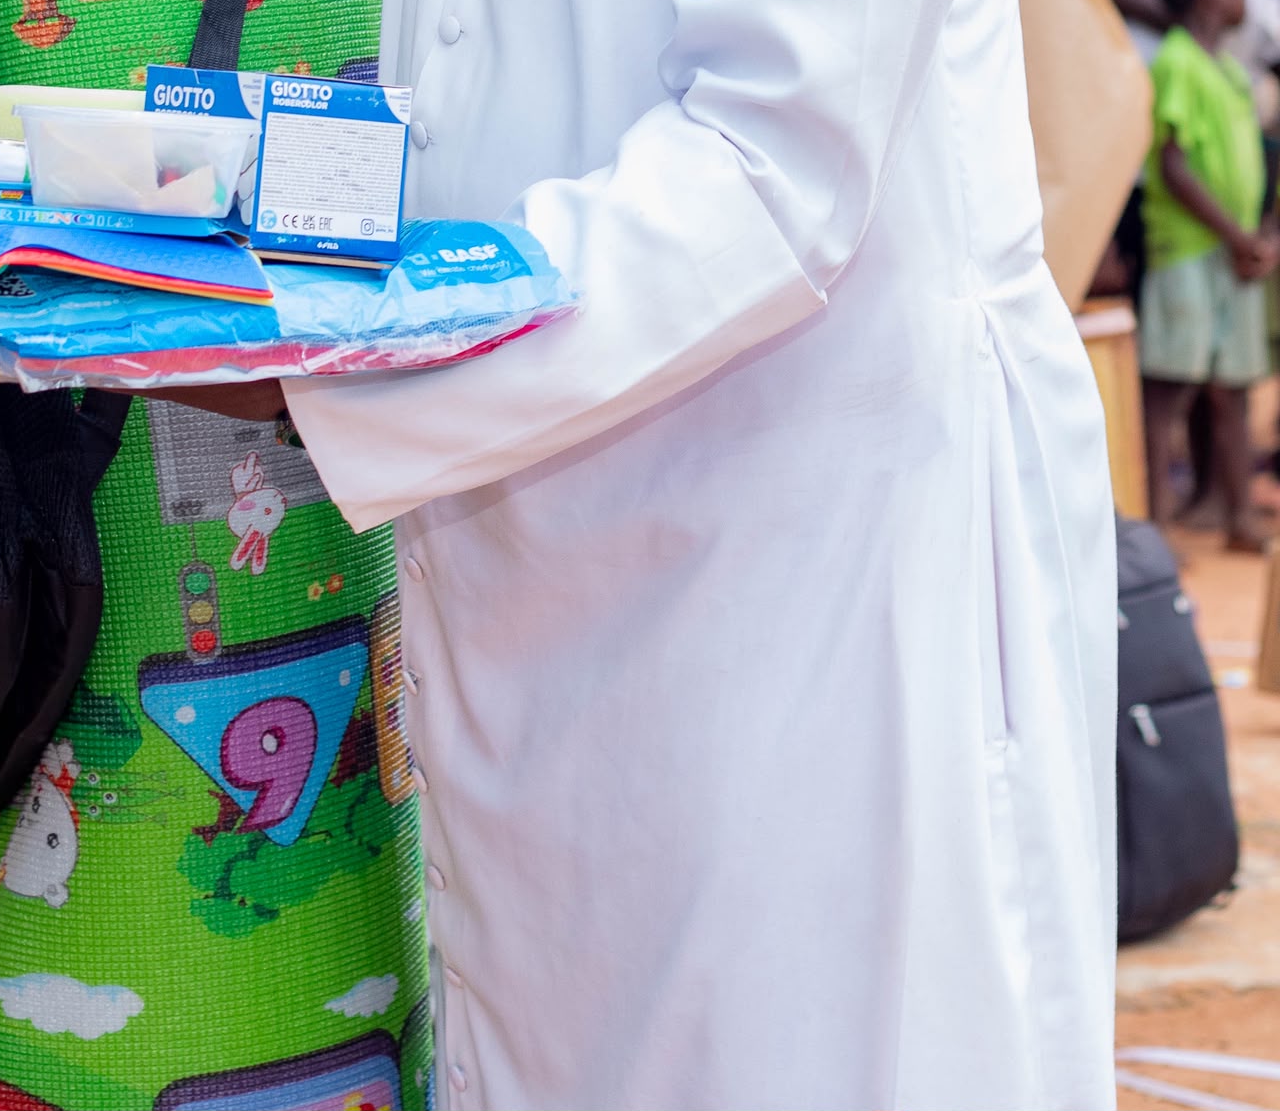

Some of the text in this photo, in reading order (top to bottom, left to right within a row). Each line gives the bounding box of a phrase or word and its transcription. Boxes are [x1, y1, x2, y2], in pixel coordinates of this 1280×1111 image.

[153, 84, 215, 110] GIOTTO
[271, 80, 333, 101] GIOTTO
[272, 97, 329, 110] ROBERCOLOR
[438, 243, 499, 263] BASF
